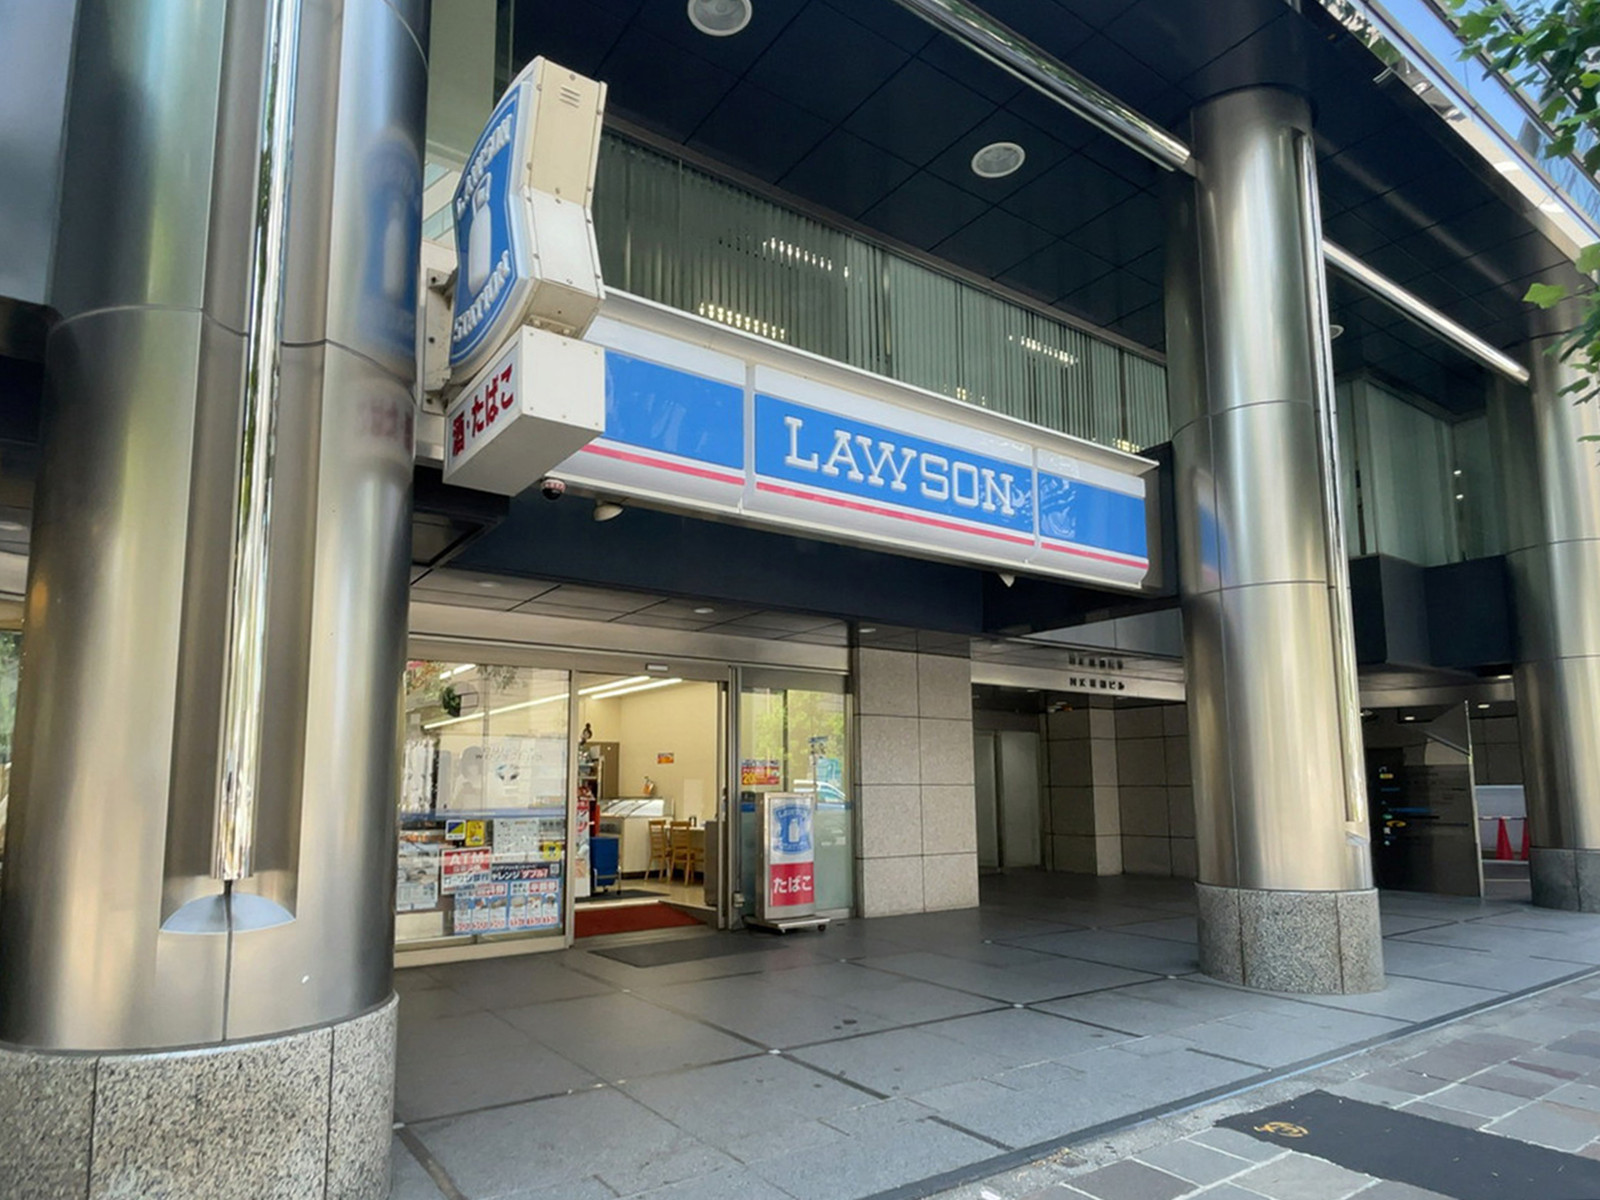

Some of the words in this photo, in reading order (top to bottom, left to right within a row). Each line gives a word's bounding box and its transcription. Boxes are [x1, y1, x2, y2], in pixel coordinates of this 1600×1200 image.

[456, 113, 513, 221] LAWSON
[452, 249, 511, 343] STATION
[784, 415, 1016, 518] LAWSON
[450, 851, 485, 866] ATM
[773, 875, 812, 894] たばこ
